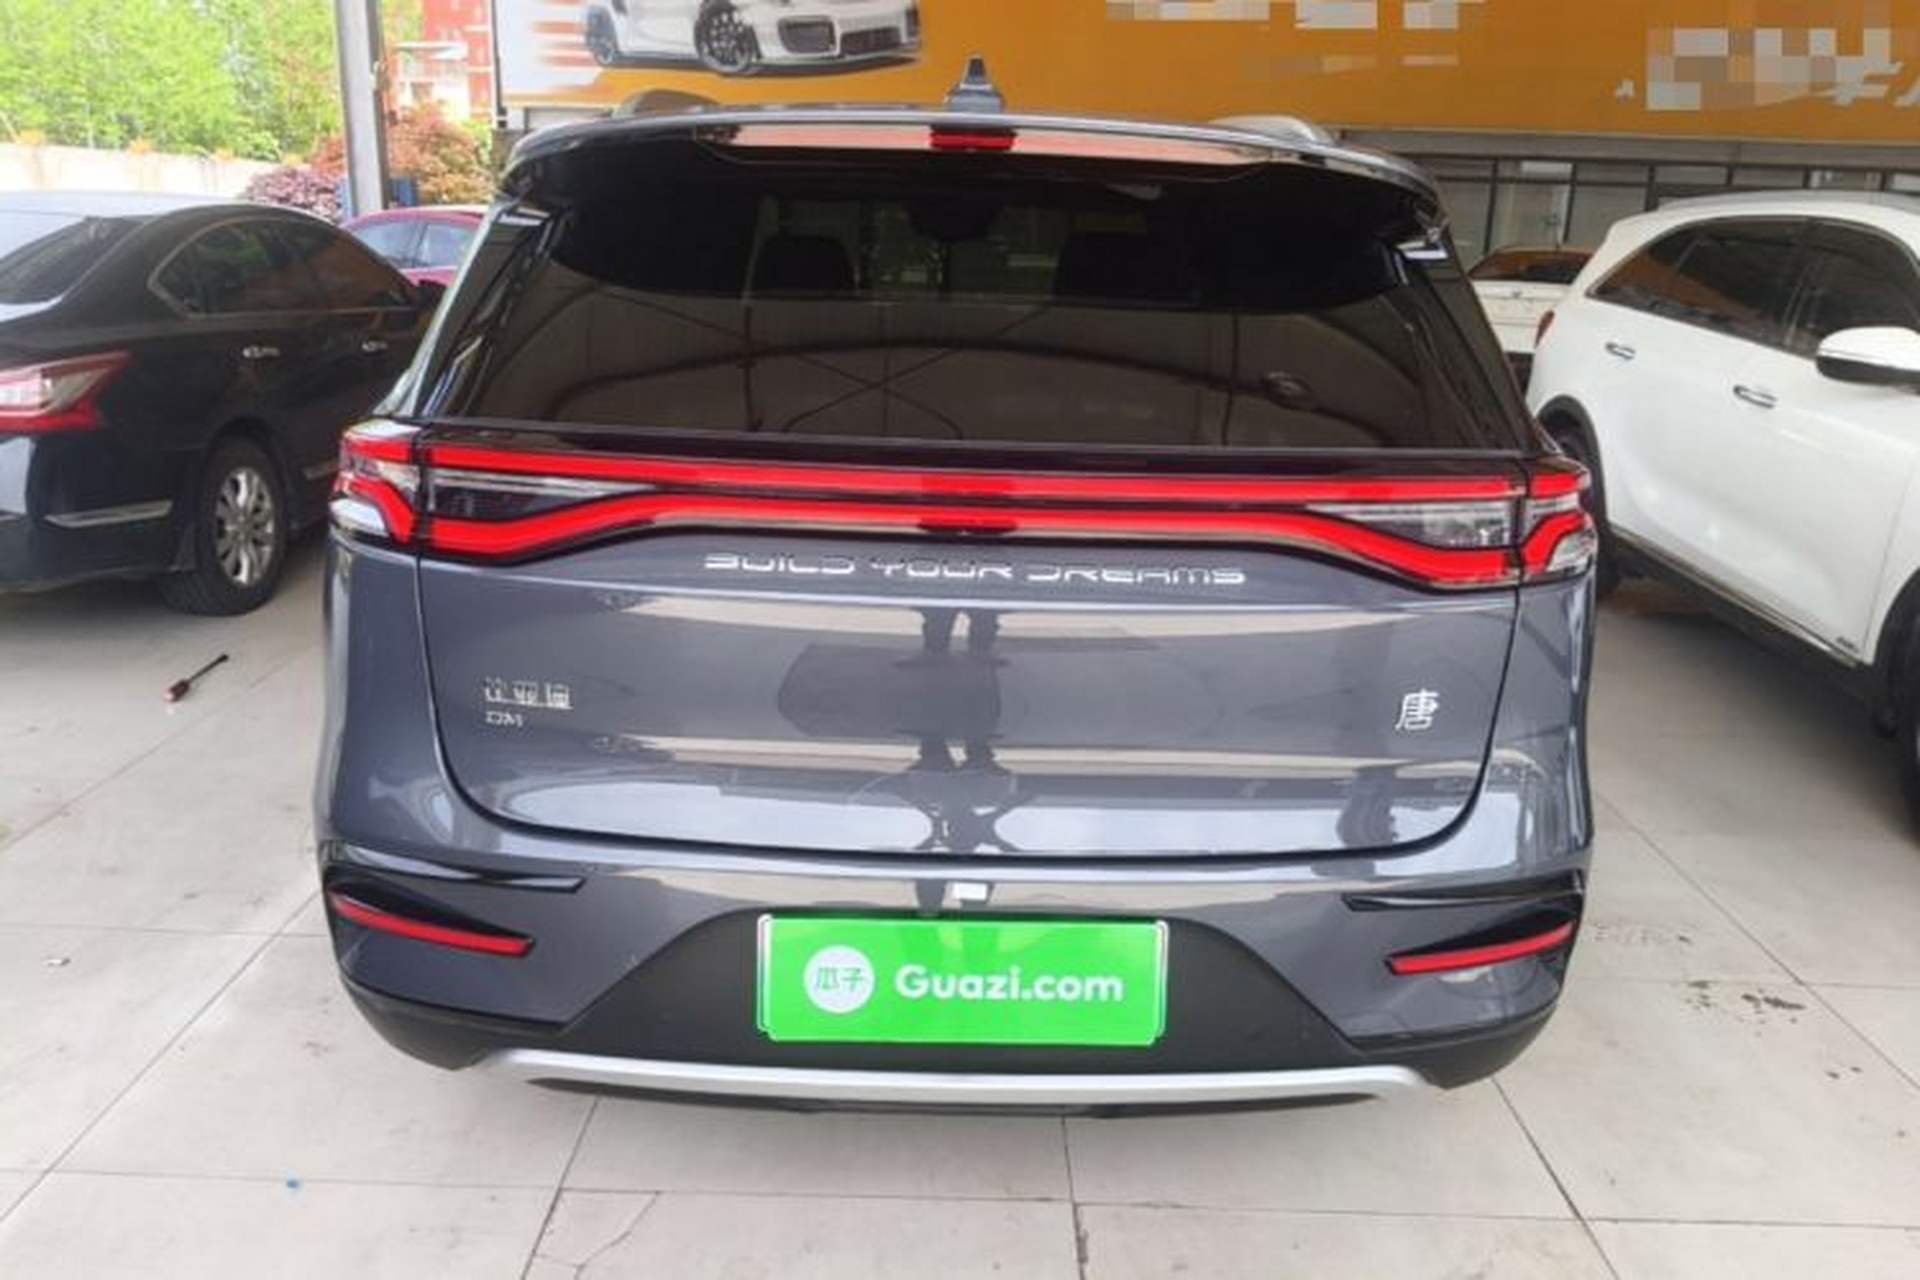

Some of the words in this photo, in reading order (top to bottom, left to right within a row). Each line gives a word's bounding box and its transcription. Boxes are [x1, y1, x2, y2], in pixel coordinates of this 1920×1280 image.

[704, 552, 855, 574] BUILD
[870, 556, 1013, 580] YOUR
[1025, 563, 1246, 585] DREAMS
[1395, 688, 1438, 730] 唐
[814, 965, 868, 993] 瓜子
[894, 963, 1124, 1002] Guazi.com
